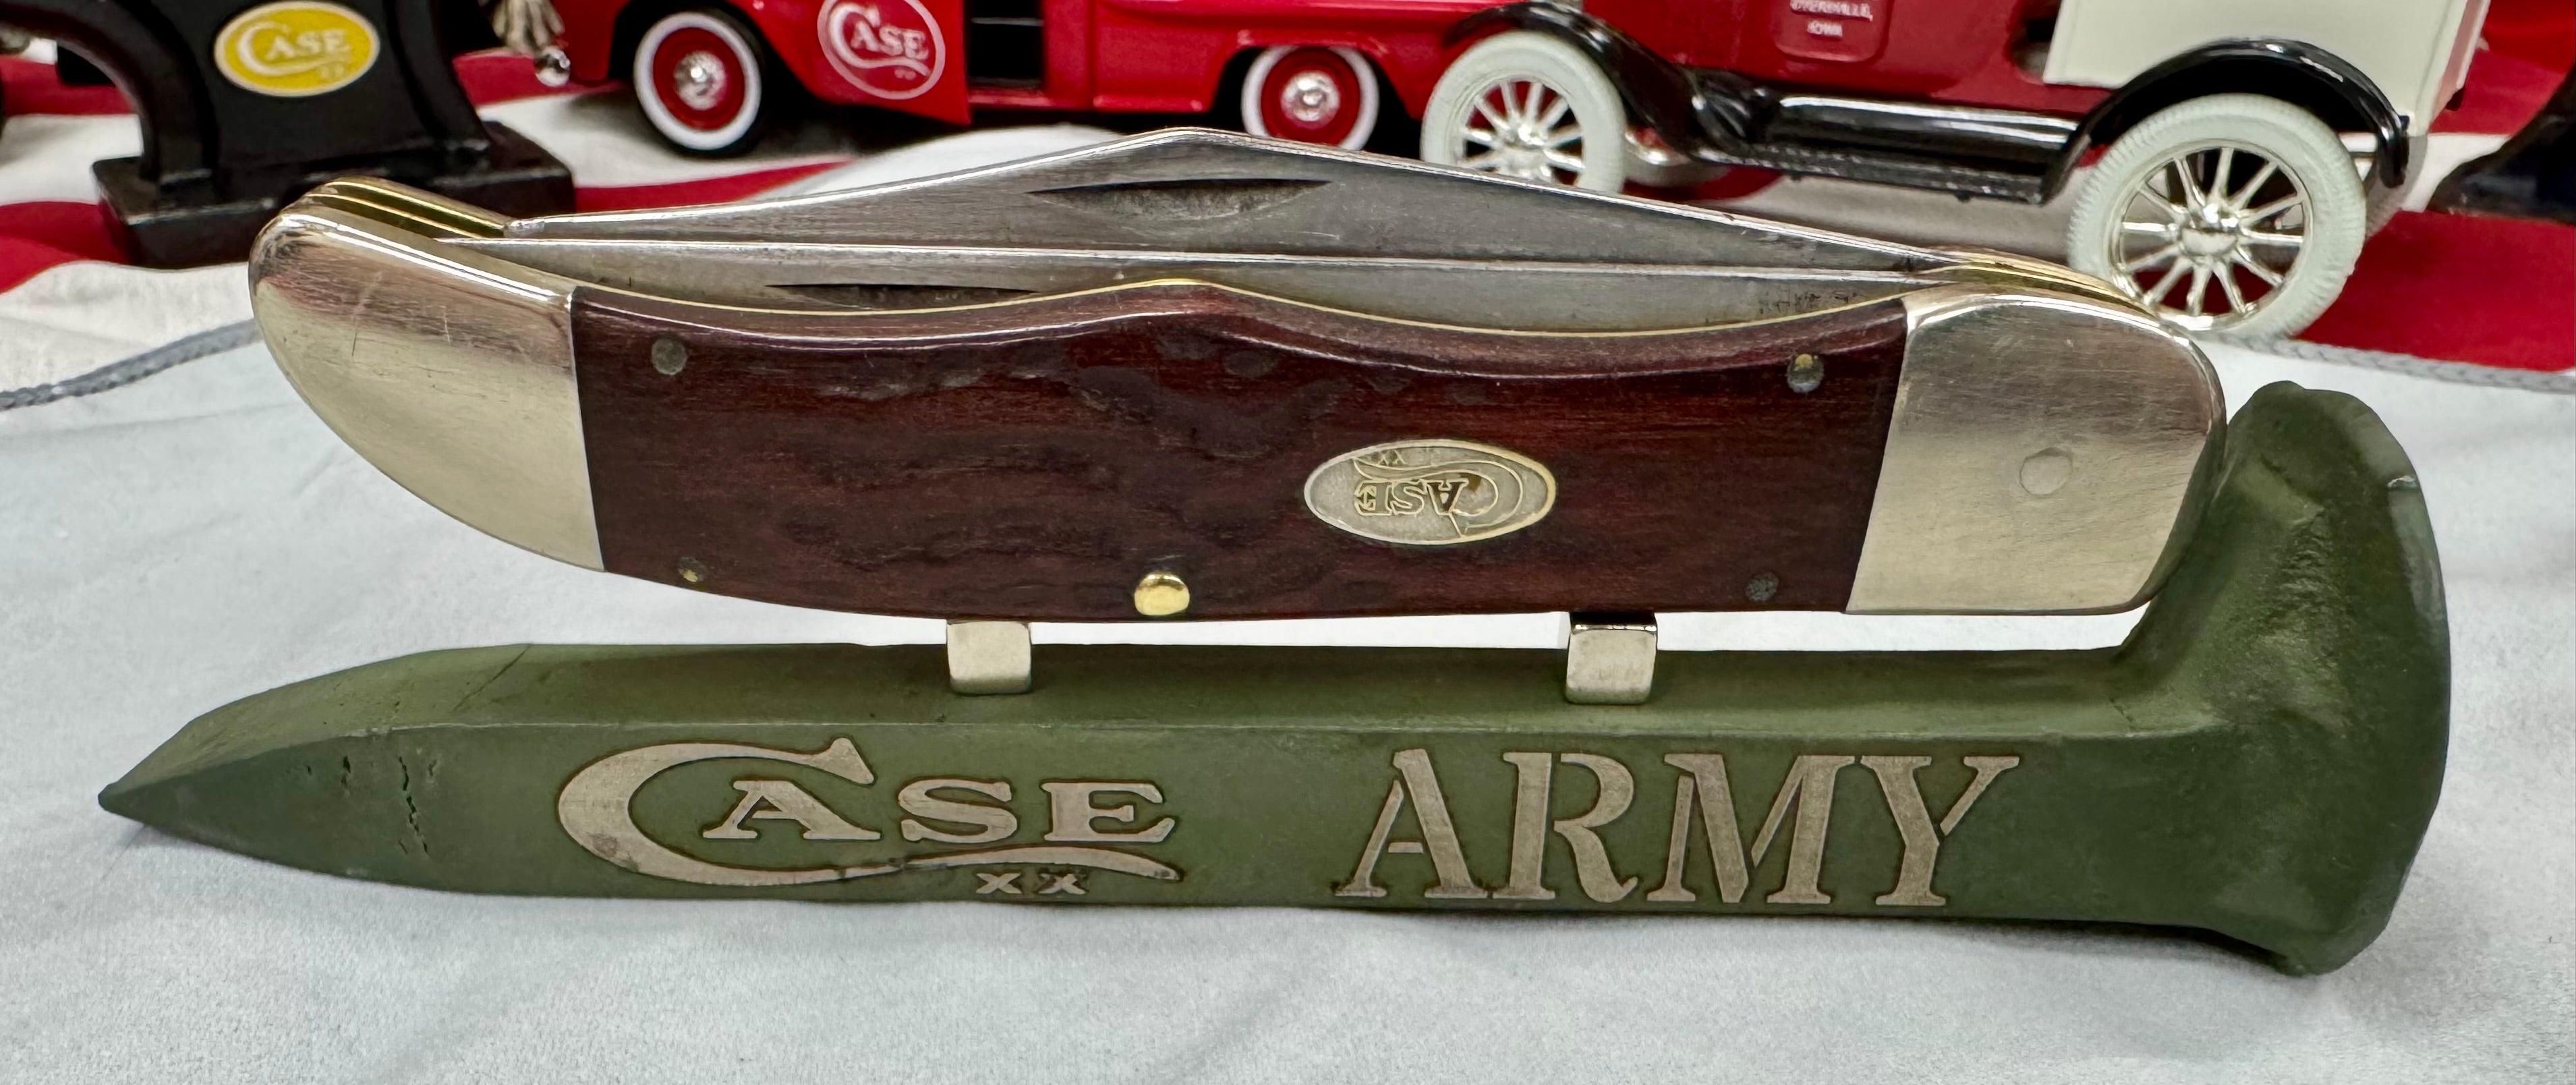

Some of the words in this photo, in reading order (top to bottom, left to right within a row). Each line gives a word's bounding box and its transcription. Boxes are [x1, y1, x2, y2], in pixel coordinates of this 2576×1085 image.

[237, 21, 352, 76] CASE
[829, 3, 931, 76] CASE
[1352, 457, 1523, 538] CASE
[558, 736, 1182, 887] CASE
[1334, 747, 2020, 906] ARMY
